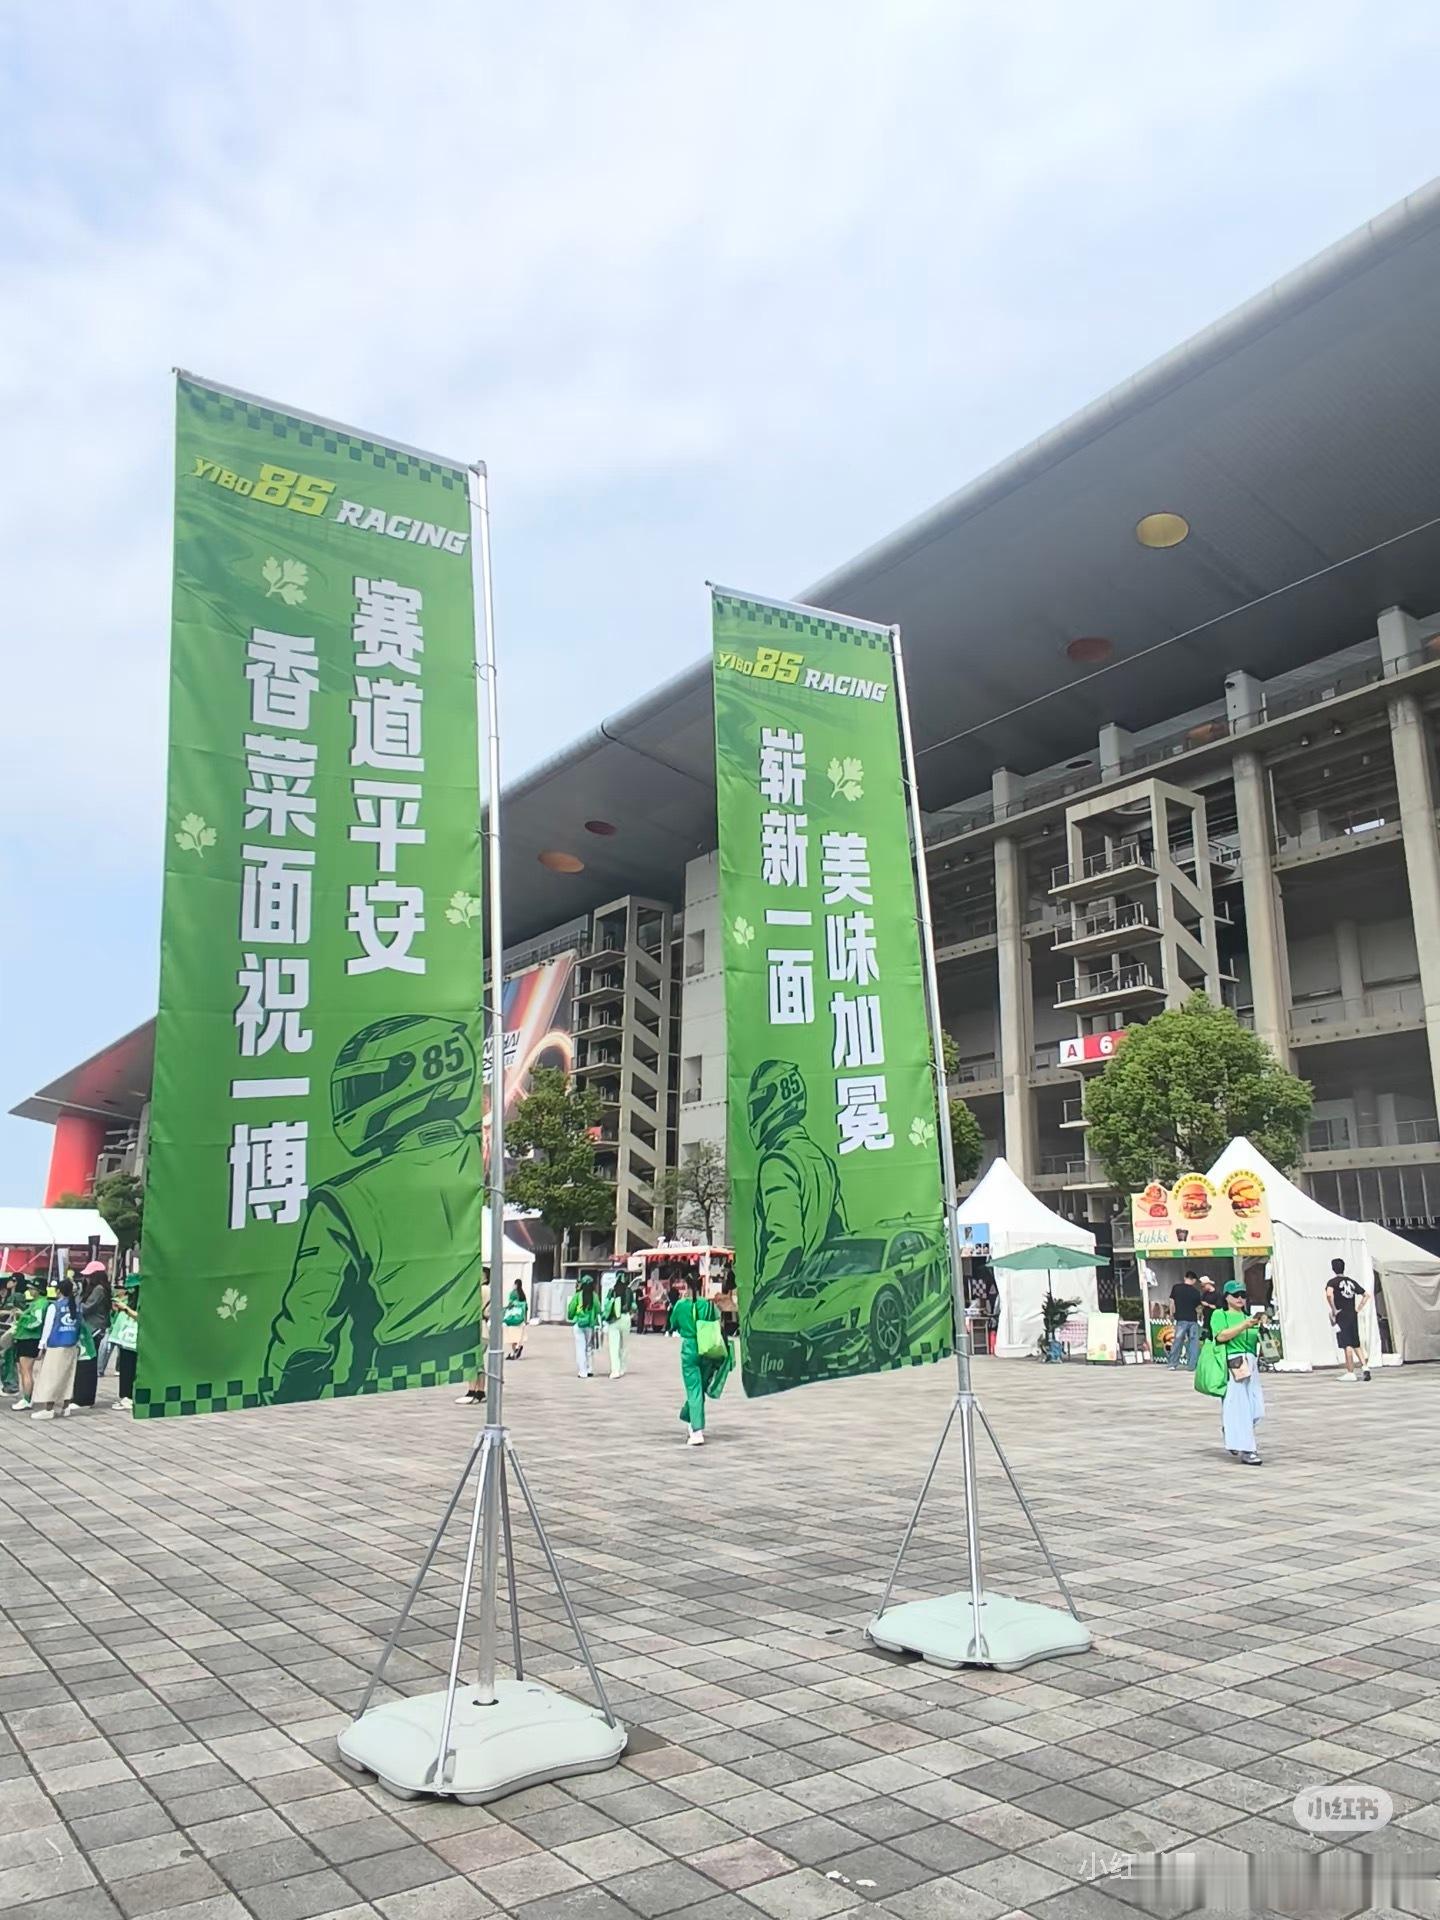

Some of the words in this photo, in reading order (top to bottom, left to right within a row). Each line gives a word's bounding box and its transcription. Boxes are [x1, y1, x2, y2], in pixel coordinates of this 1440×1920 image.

[189, 457, 254, 497] YIBO
[335, 499, 470, 556] RACING
[803, 667, 889, 702] RACING
[348, 577, 426, 977] 赛道平安
[760, 727, 815, 1025] 崭新一面
[230, 627, 319, 1230] 香菜面祝一博
[821, 831, 895, 1154] 美味加冕
[422, 1036, 464, 1080] 85
[779, 1072, 800, 1101] 85
[1067, 1043, 1077, 1058] A
[1099, 1035, 1113, 1054] 6
